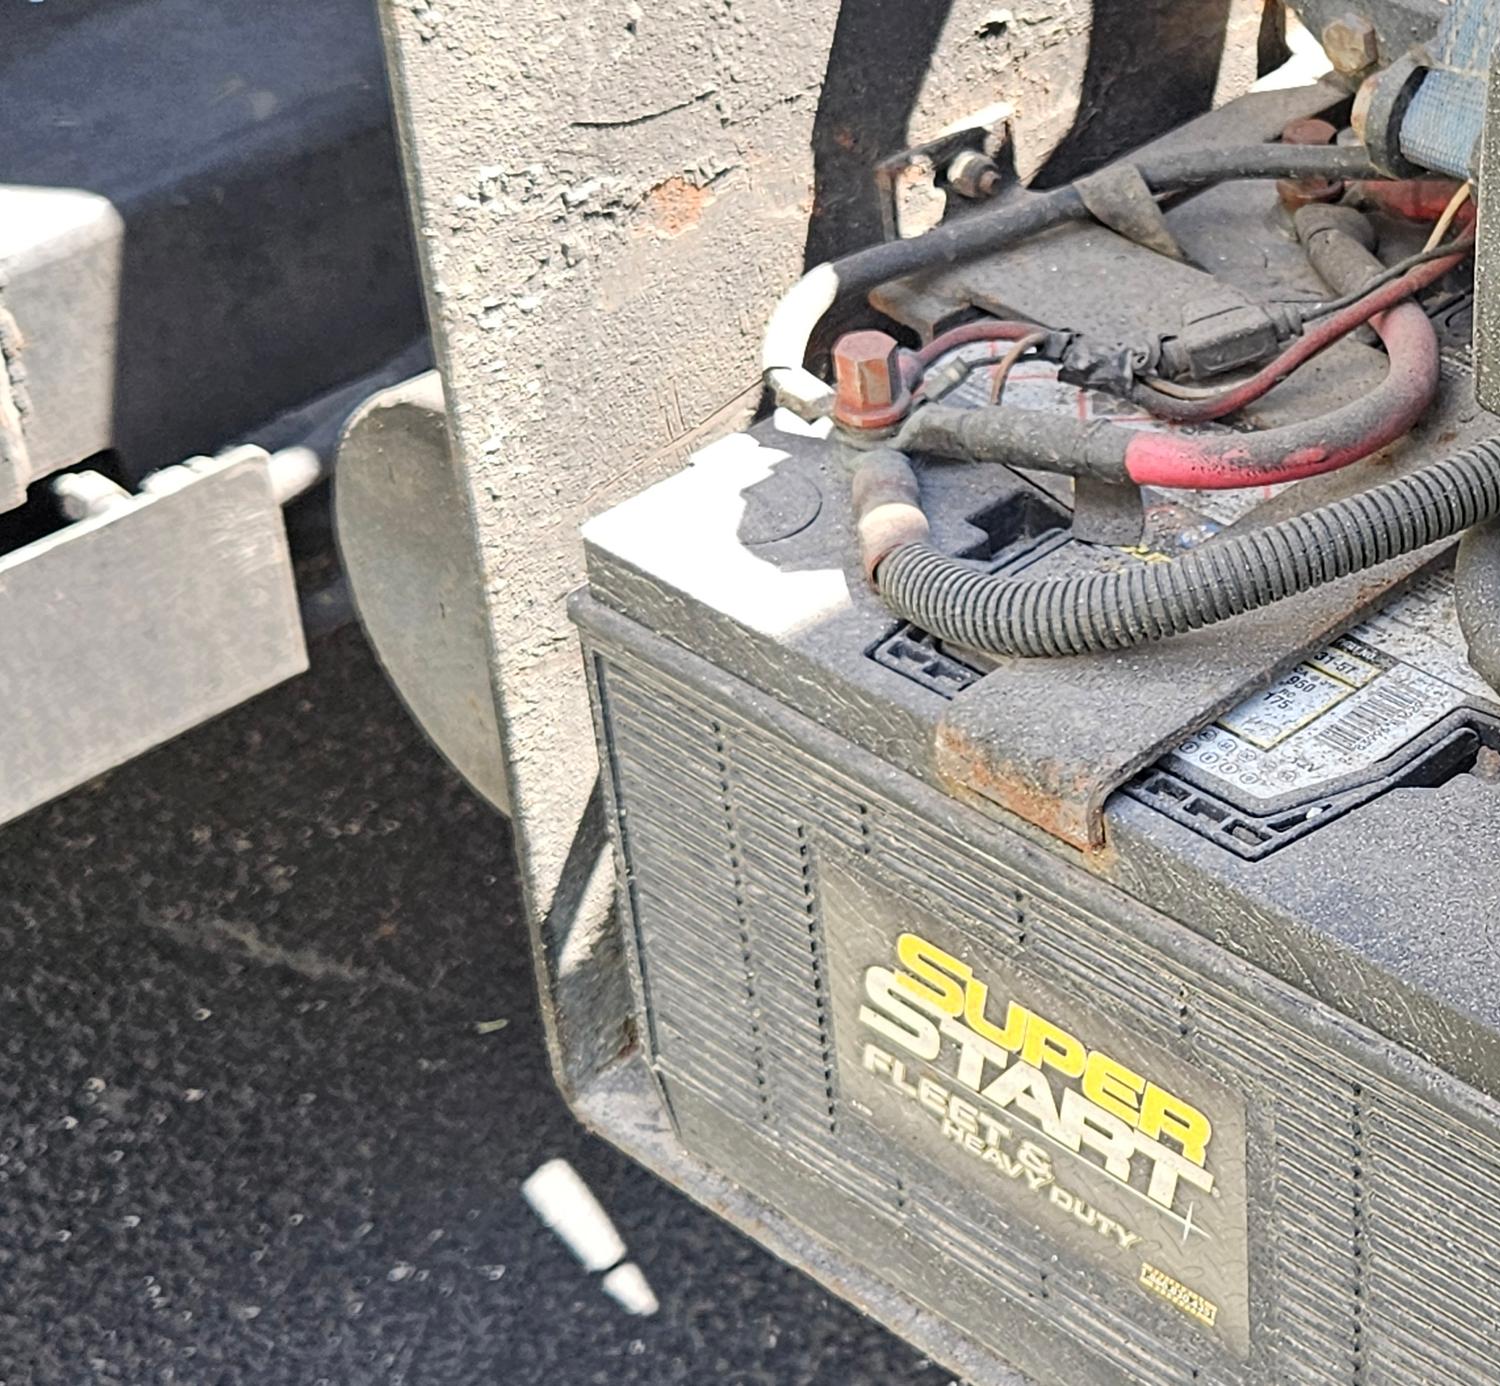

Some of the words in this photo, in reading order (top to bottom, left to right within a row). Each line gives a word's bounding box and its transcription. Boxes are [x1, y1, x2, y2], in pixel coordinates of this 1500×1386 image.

[1263, 691, 1291, 710] 175
[1286, 675, 1317, 693] 950
[858, 965, 1215, 1210] START
[863, 1043, 1014, 1147] FLEET
[1016, 1140, 1056, 1180] &
[896, 932, 1213, 1169] SUPER
[941, 1116, 1056, 1193] HEAVY
[1049, 1183, 1144, 1250] DUTY
